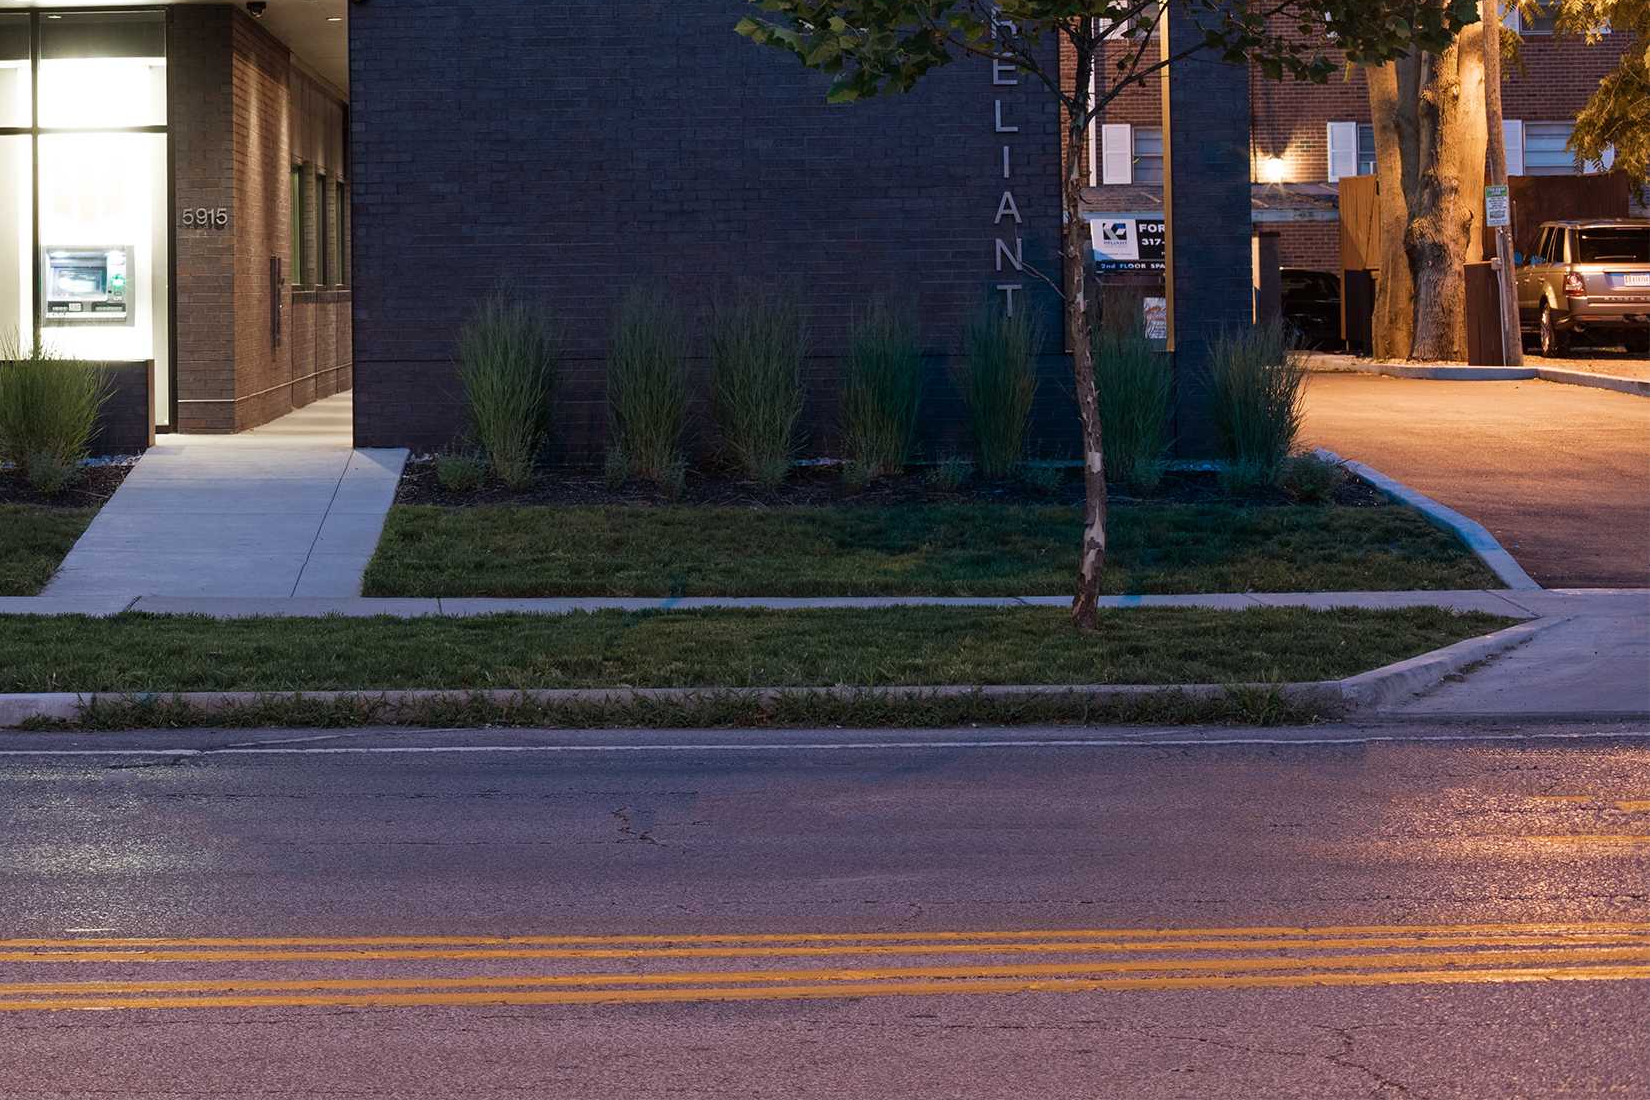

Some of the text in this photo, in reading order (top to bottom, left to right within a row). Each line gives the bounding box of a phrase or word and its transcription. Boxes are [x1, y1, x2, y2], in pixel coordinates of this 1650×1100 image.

[182, 207, 228, 226] 5915
[1138, 224, 1165, 233] FOR
[1141, 238, 1165, 246] 317-
